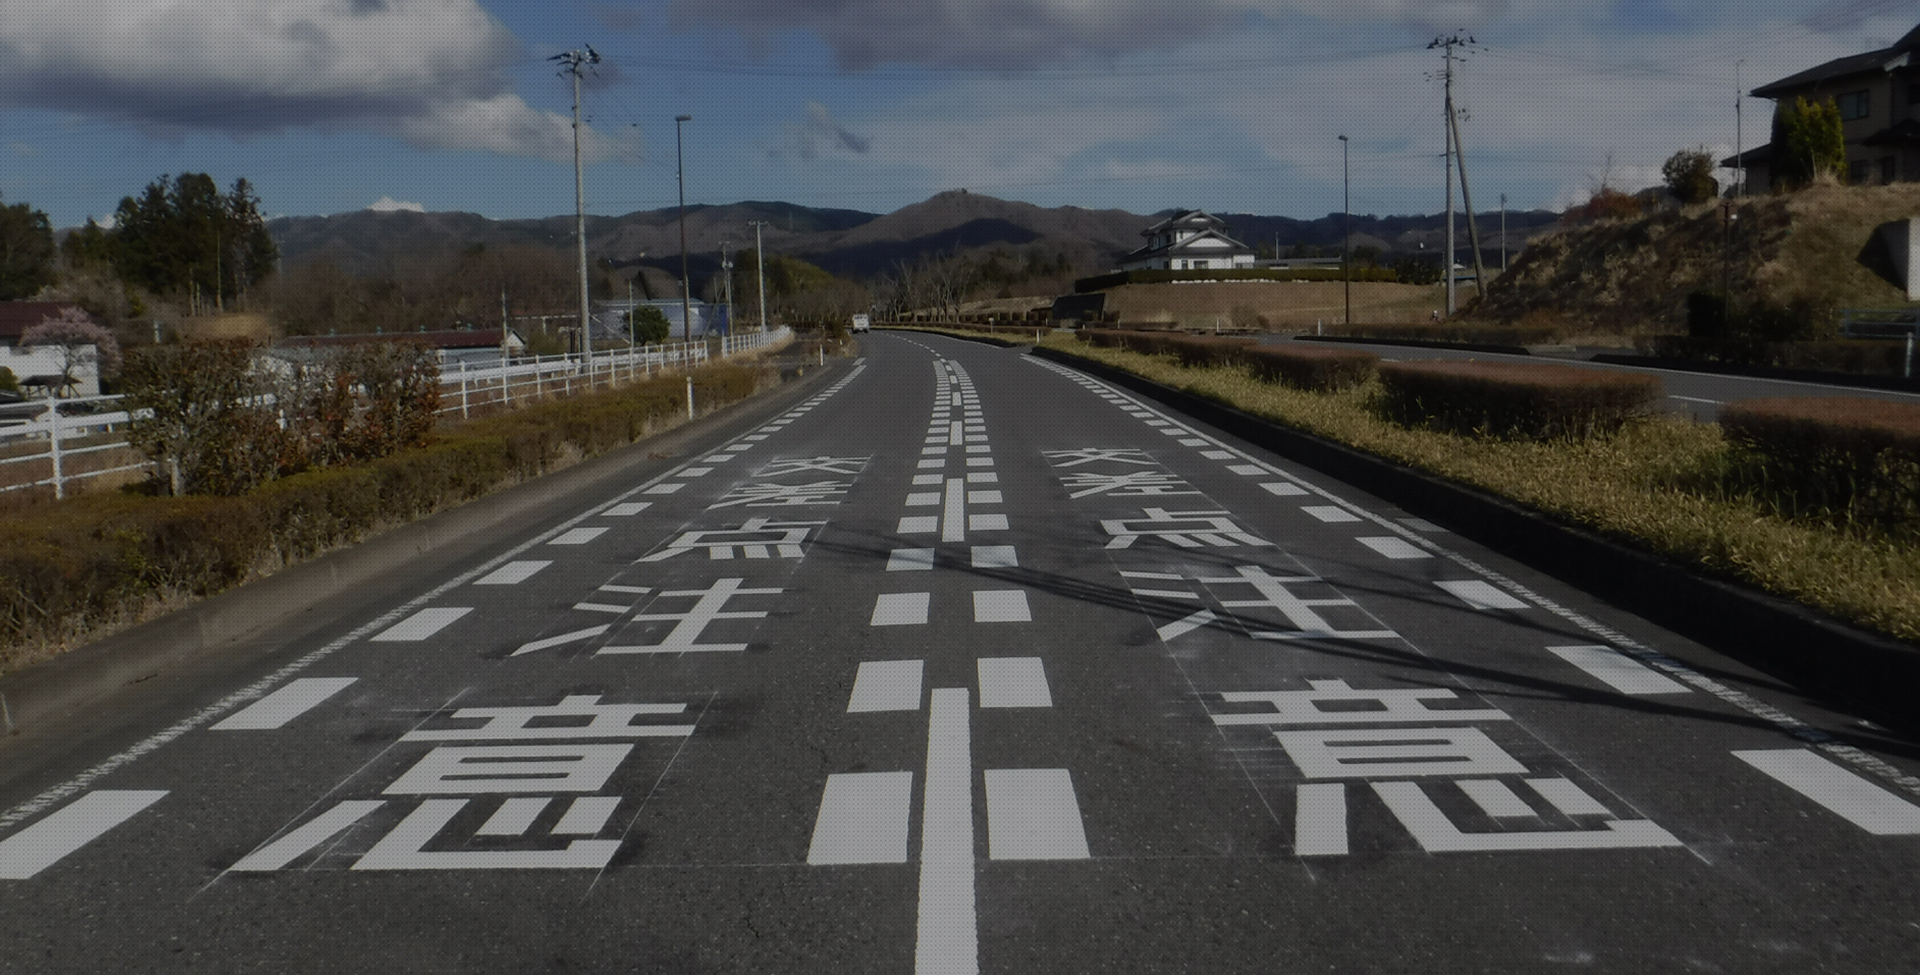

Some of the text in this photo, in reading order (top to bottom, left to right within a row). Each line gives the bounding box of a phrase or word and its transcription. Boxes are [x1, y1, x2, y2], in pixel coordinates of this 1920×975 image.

[230, 456, 870, 871] 交差点注意
[1042, 448, 1683, 856] 交差点注意
